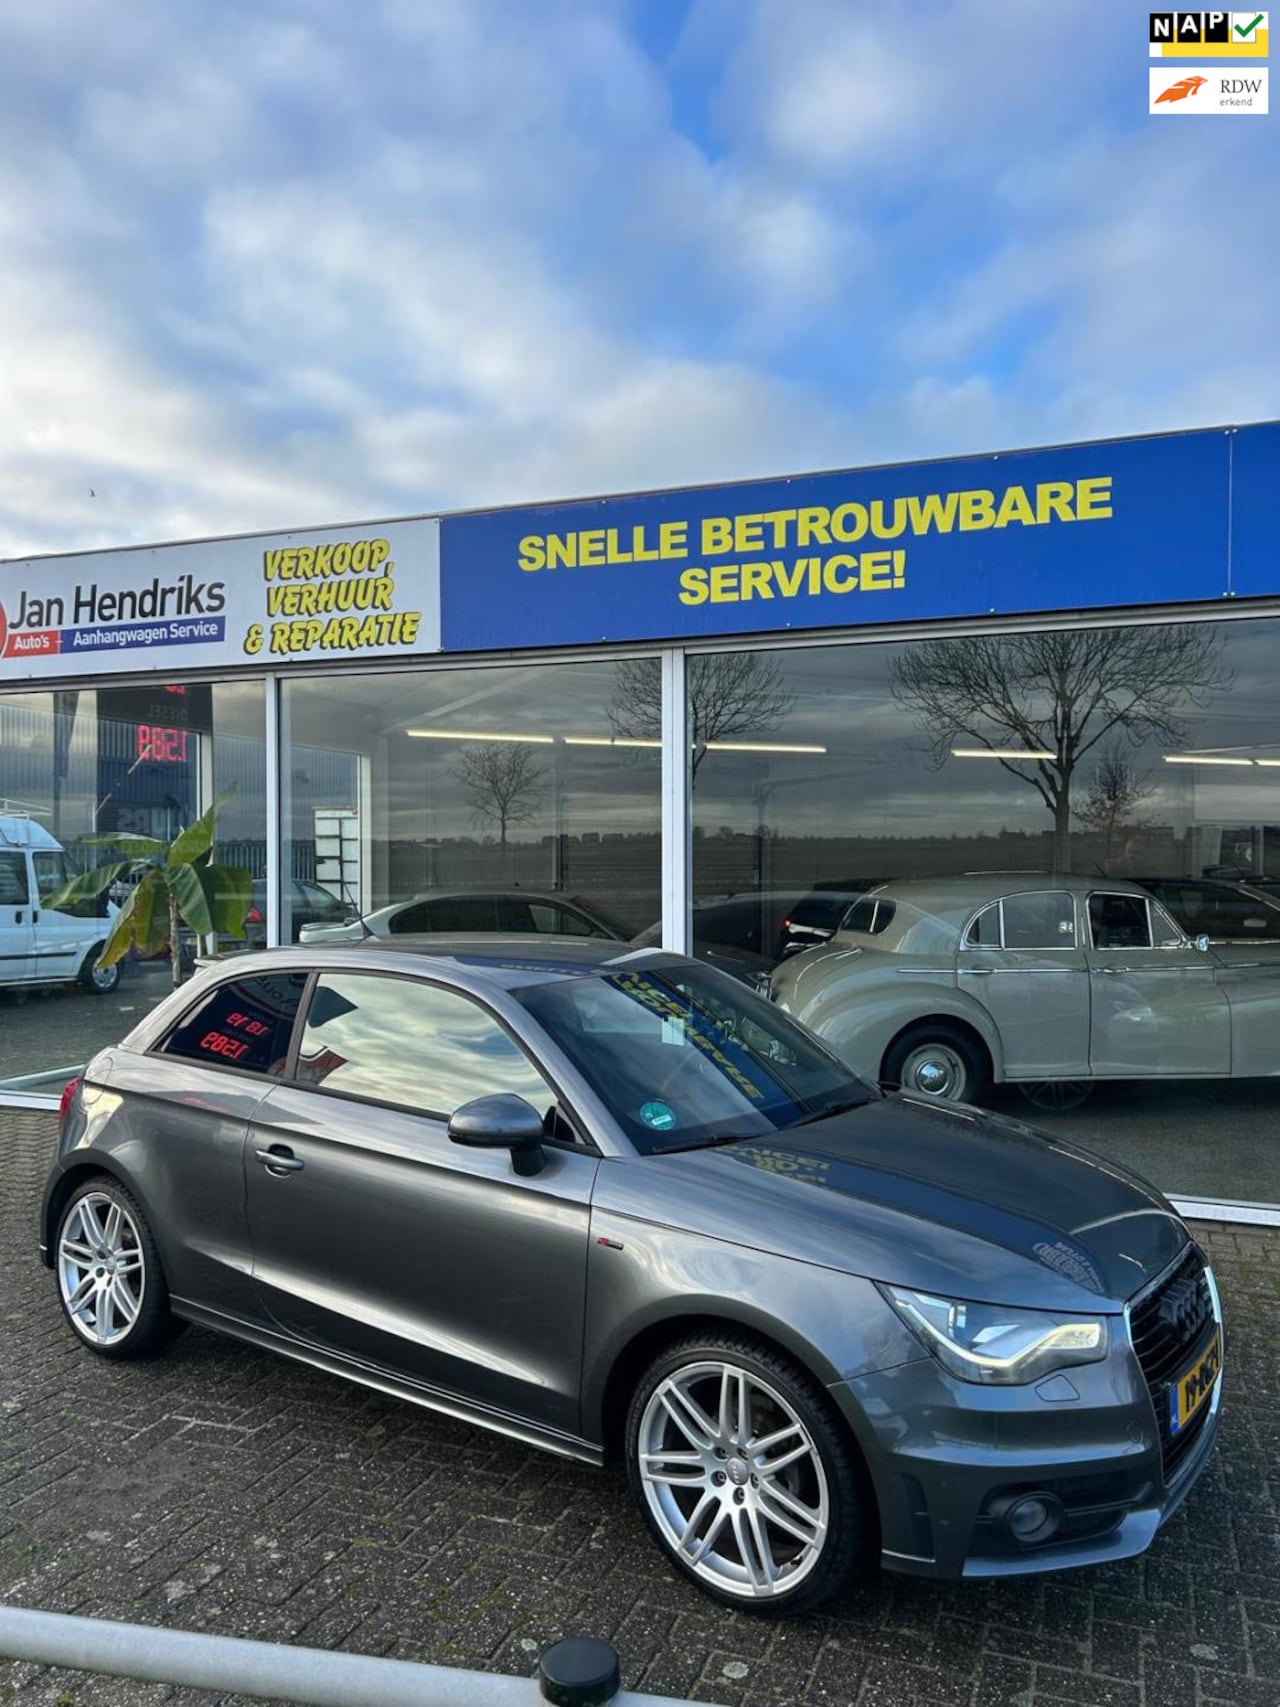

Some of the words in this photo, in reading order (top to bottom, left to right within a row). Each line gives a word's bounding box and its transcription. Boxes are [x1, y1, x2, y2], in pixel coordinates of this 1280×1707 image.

[518, 520, 688, 573] SNELLE
[701, 476, 1114, 556] BETROUWBARE
[263, 538, 395, 582] VERKOOP,
[678, 550, 907, 607] SERVICE!
[8, 590, 65, 630] Jan
[73, 574, 226, 625] Hendriks
[266, 576, 394, 617] VERHUUR
[13, 634, 50, 651] Auto's
[73, 628, 168, 647] Aanhangwagen
[169, 620, 219, 639] Service
[243, 624, 265, 655] &
[270, 611, 422, 654] REPARATIE
